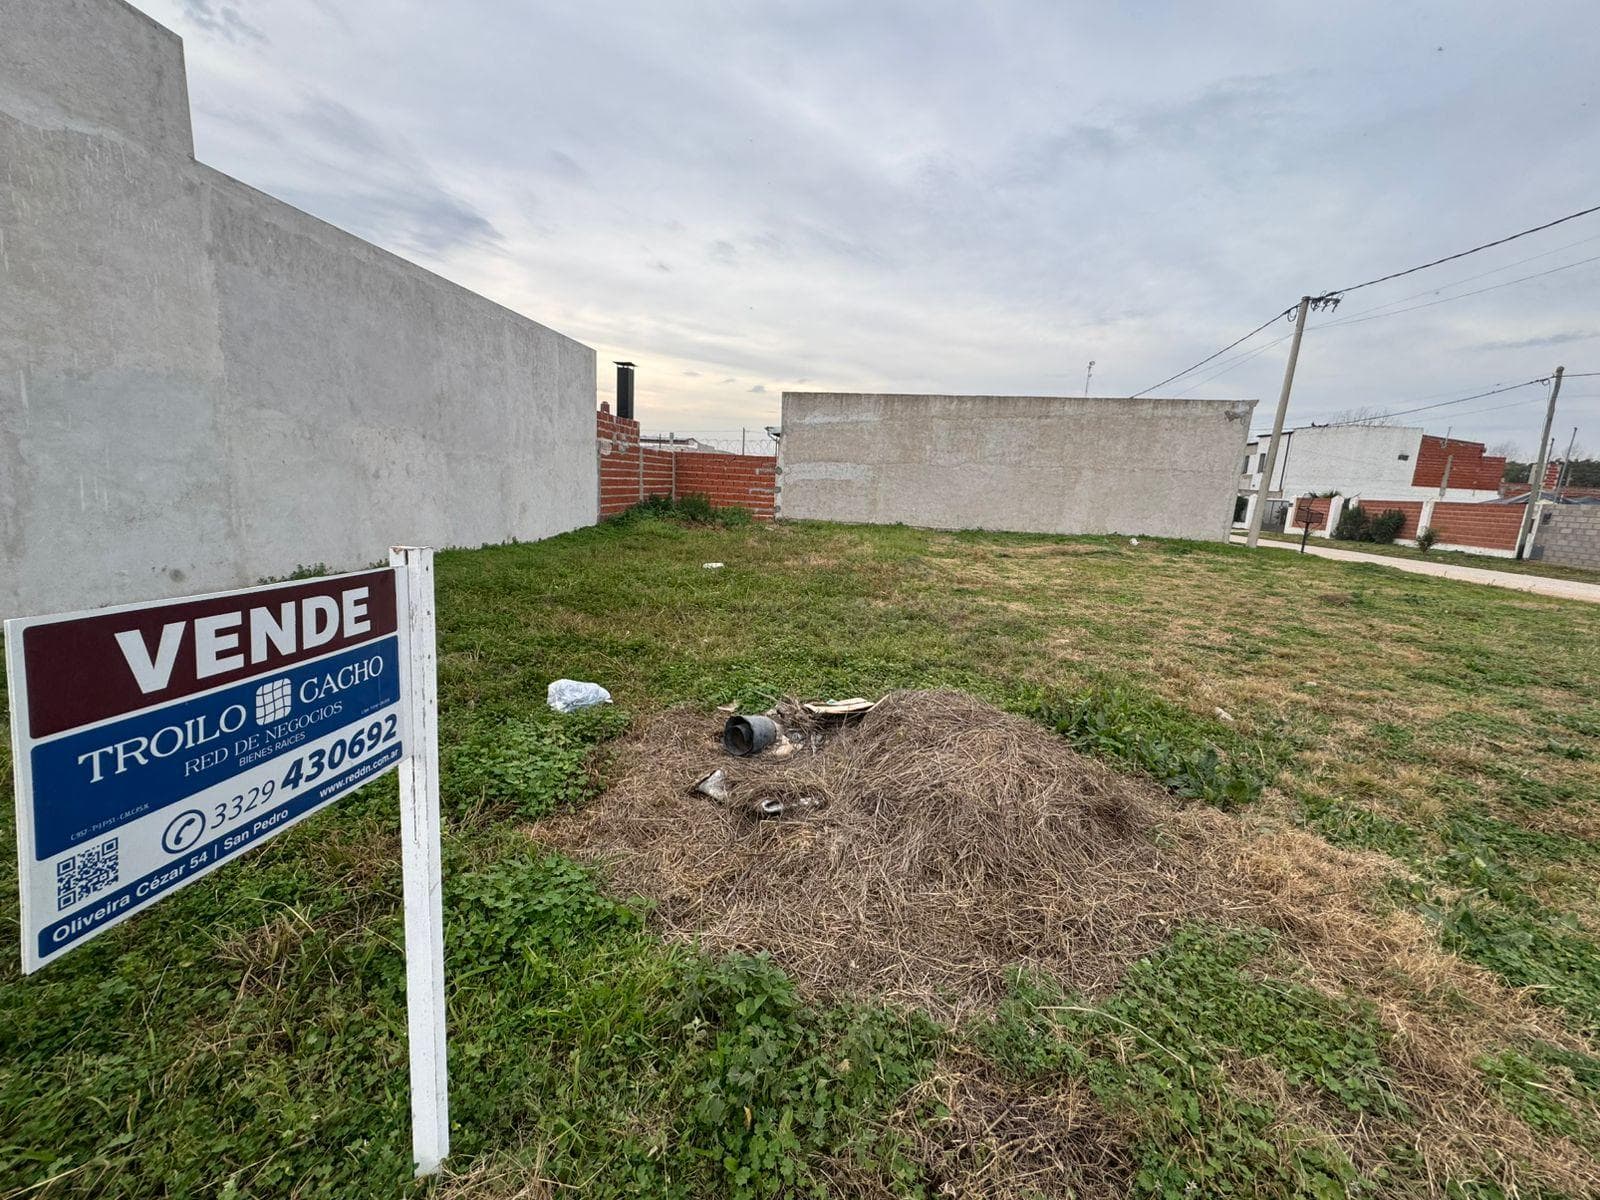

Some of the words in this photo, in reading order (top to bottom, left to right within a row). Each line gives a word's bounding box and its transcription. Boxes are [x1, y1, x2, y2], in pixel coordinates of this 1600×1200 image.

[114, 586, 372, 694] VENDE
[77, 704, 247, 784] TROILO
[299, 655, 384, 704] CACHO
[184, 747, 228, 777] RED
[234, 733, 260, 757] DE
[264, 700, 344, 744] NEGOCIOS
[211, 779, 275, 829] 3329
[280, 713, 398, 791] 430692
[239, 744, 273, 767] BIENES
[275, 731, 306, 750] RAICES
[319, 748, 399, 799] www.reddn.com.ar
[52, 893, 131, 943] Oliveira
[135, 864, 186, 897] Cézar
[189, 850, 208, 869] 54
[223, 831, 250, 851] San
[252, 808, 290, 836] Pedro
